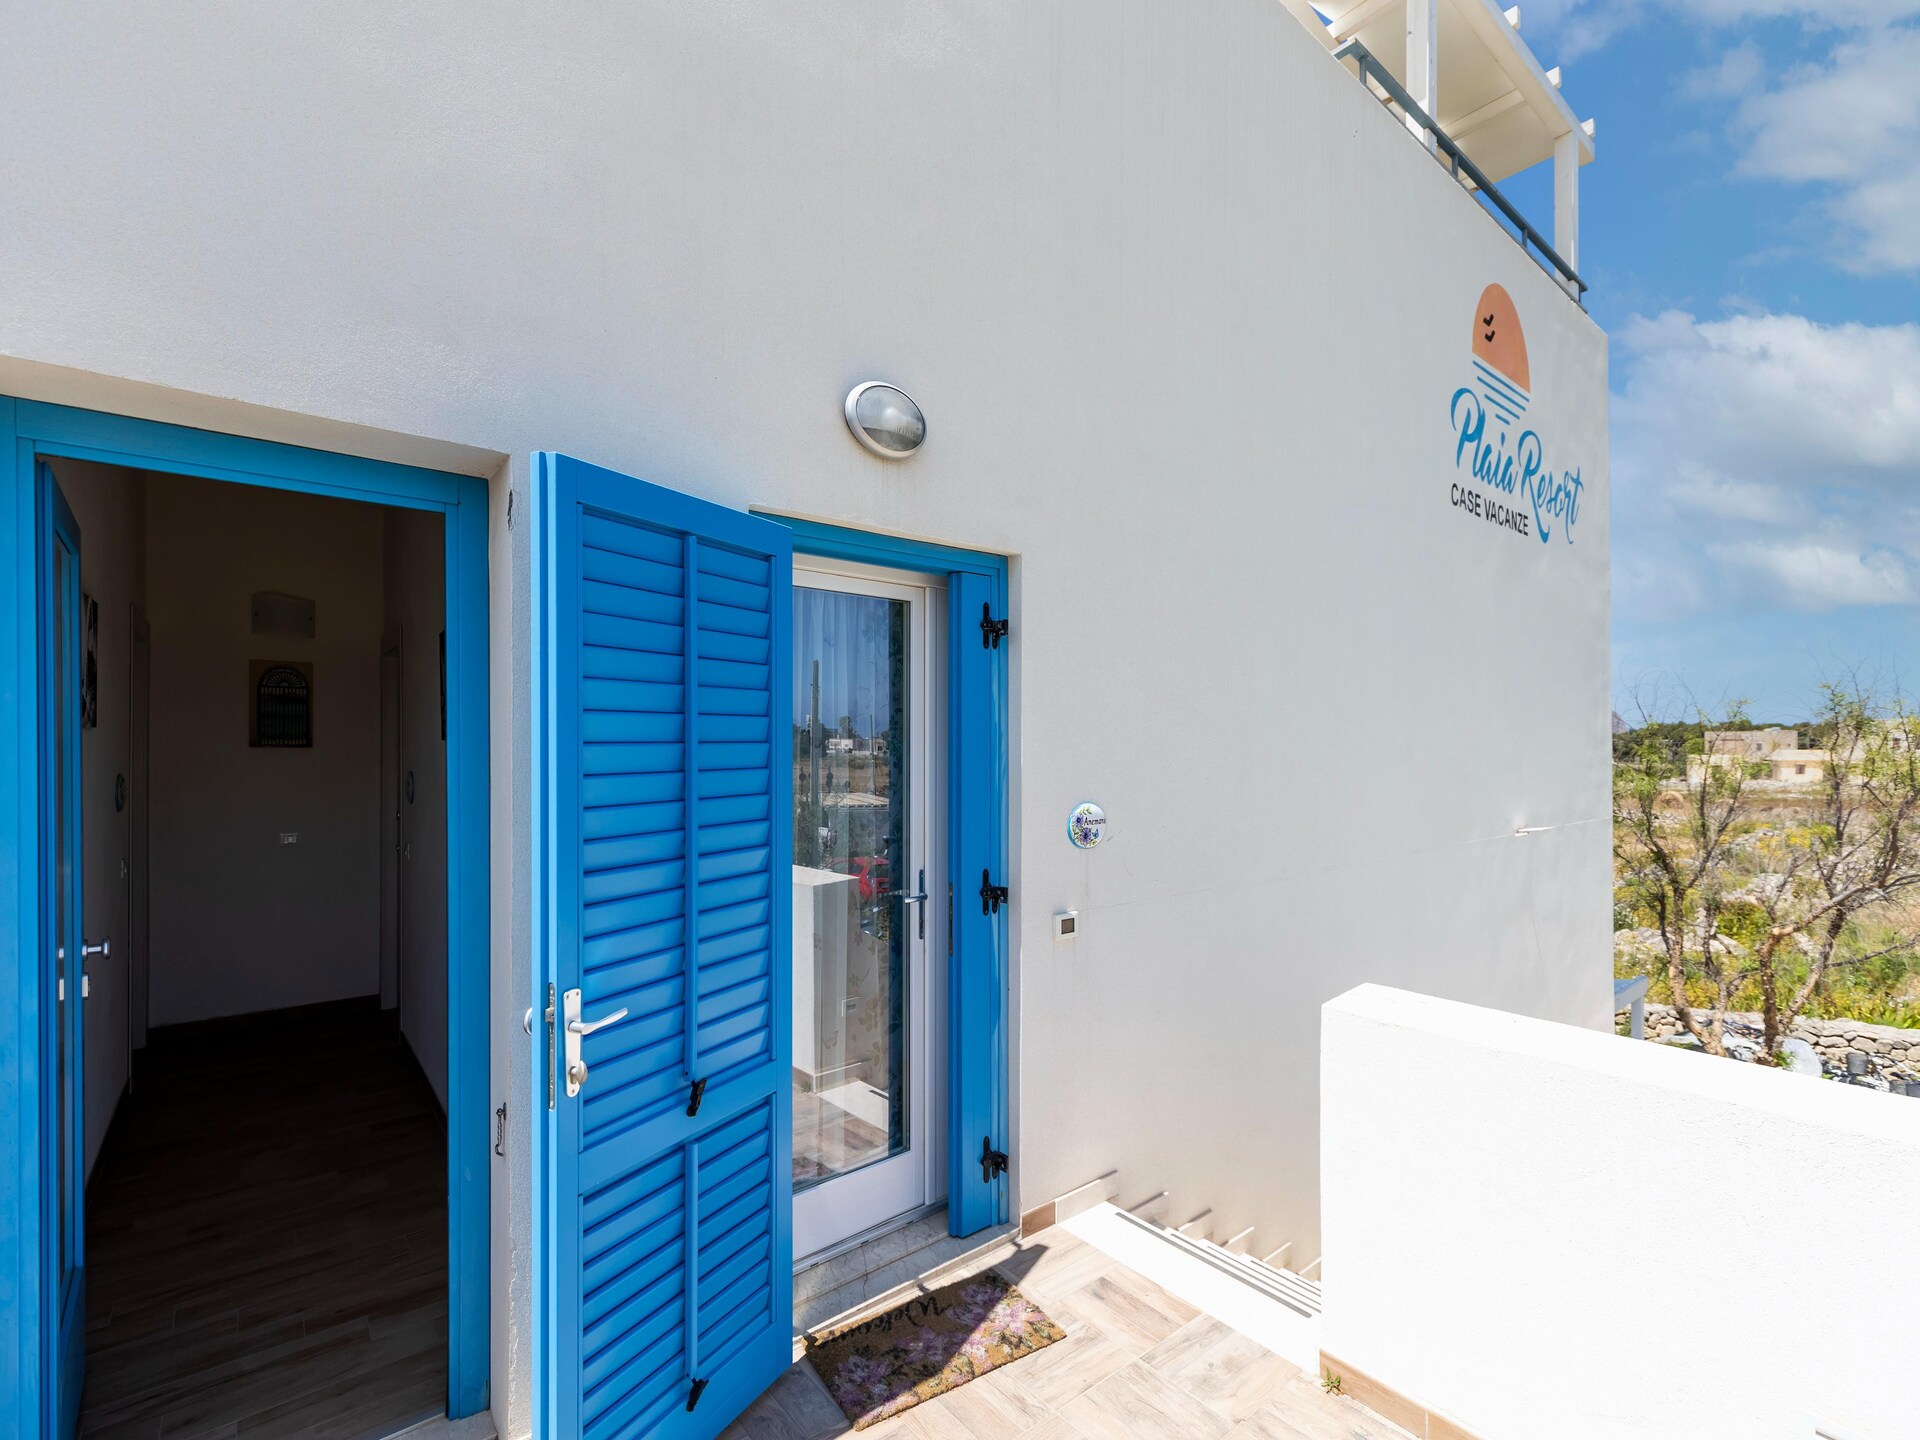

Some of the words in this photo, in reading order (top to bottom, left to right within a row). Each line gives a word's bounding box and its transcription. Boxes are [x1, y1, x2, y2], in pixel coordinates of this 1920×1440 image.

[1450, 387, 1518, 495] Plaia
[1517, 430, 1584, 544] Resort
[1451, 483, 1481, 518] CASE
[1484, 497, 1529, 536] VACANZE
